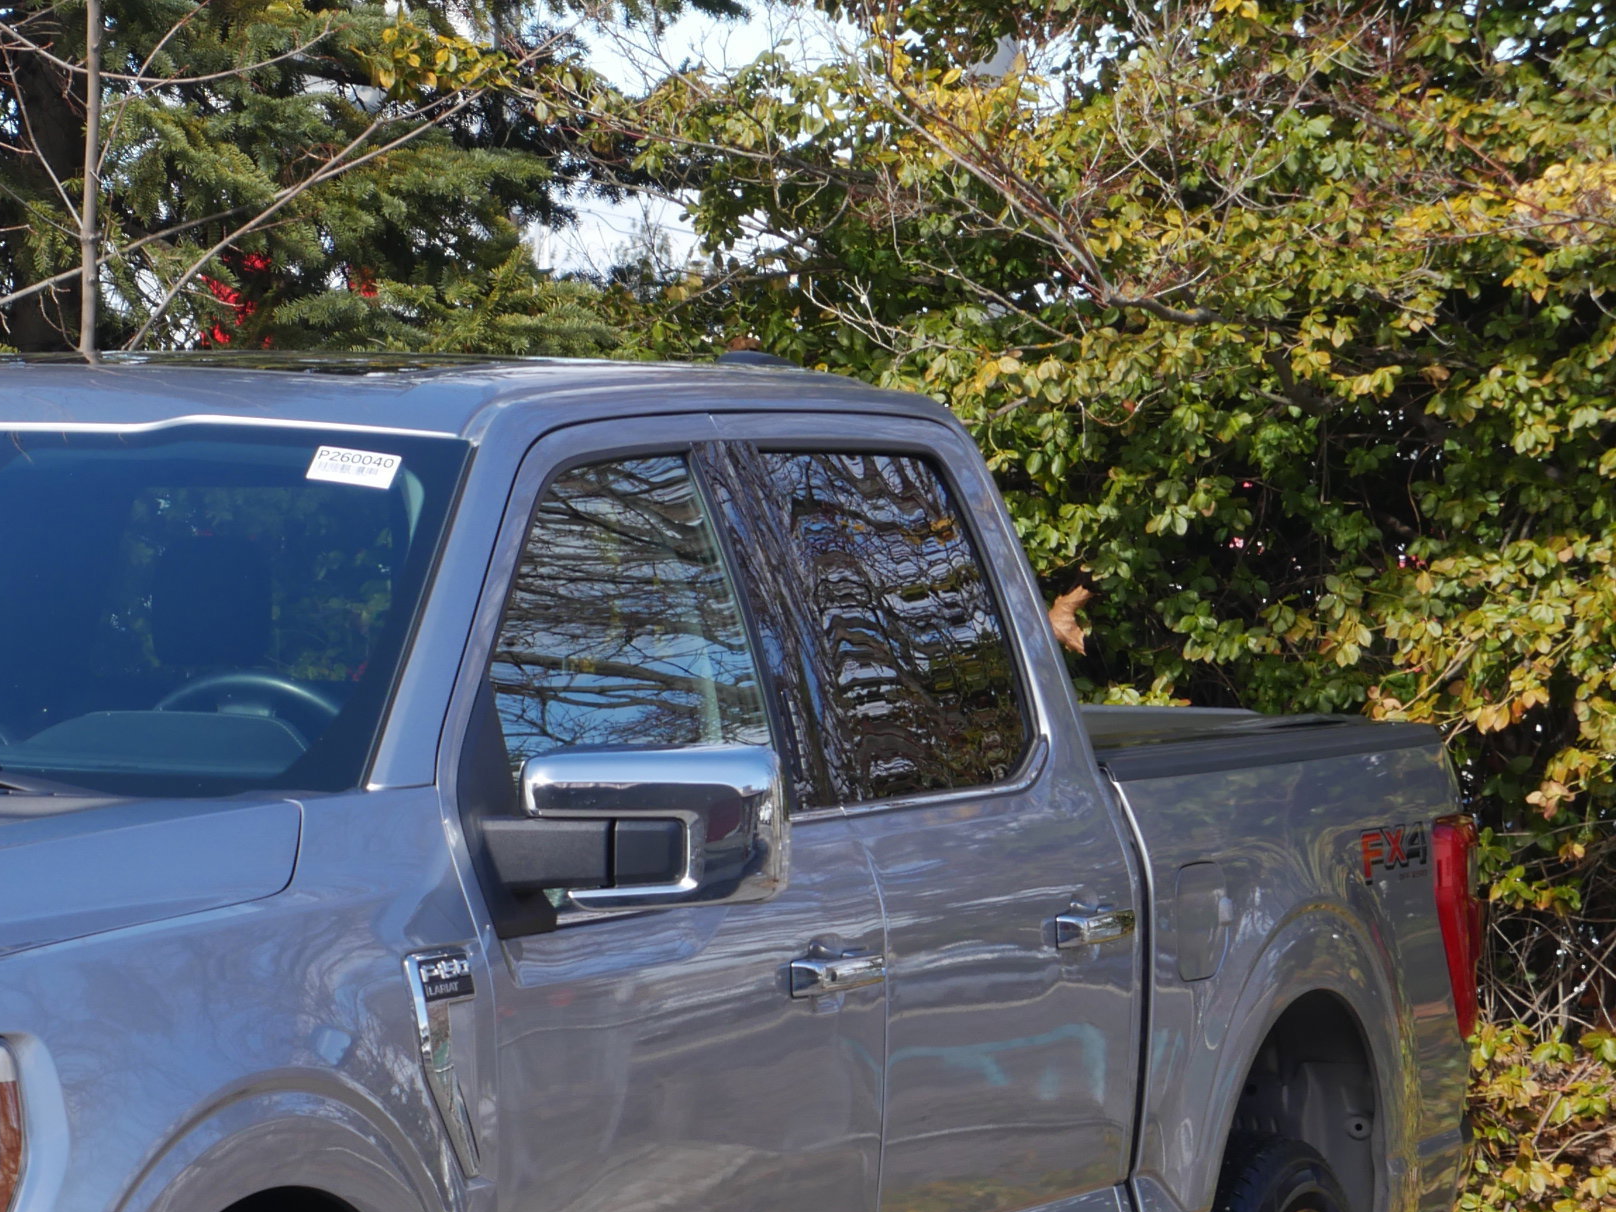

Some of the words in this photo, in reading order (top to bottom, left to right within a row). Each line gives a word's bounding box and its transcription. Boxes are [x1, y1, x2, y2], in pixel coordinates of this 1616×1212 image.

[318, 450, 394, 468] P260040
[1360, 821, 1427, 886] FX4
[429, 982, 459, 996] LARIAT
